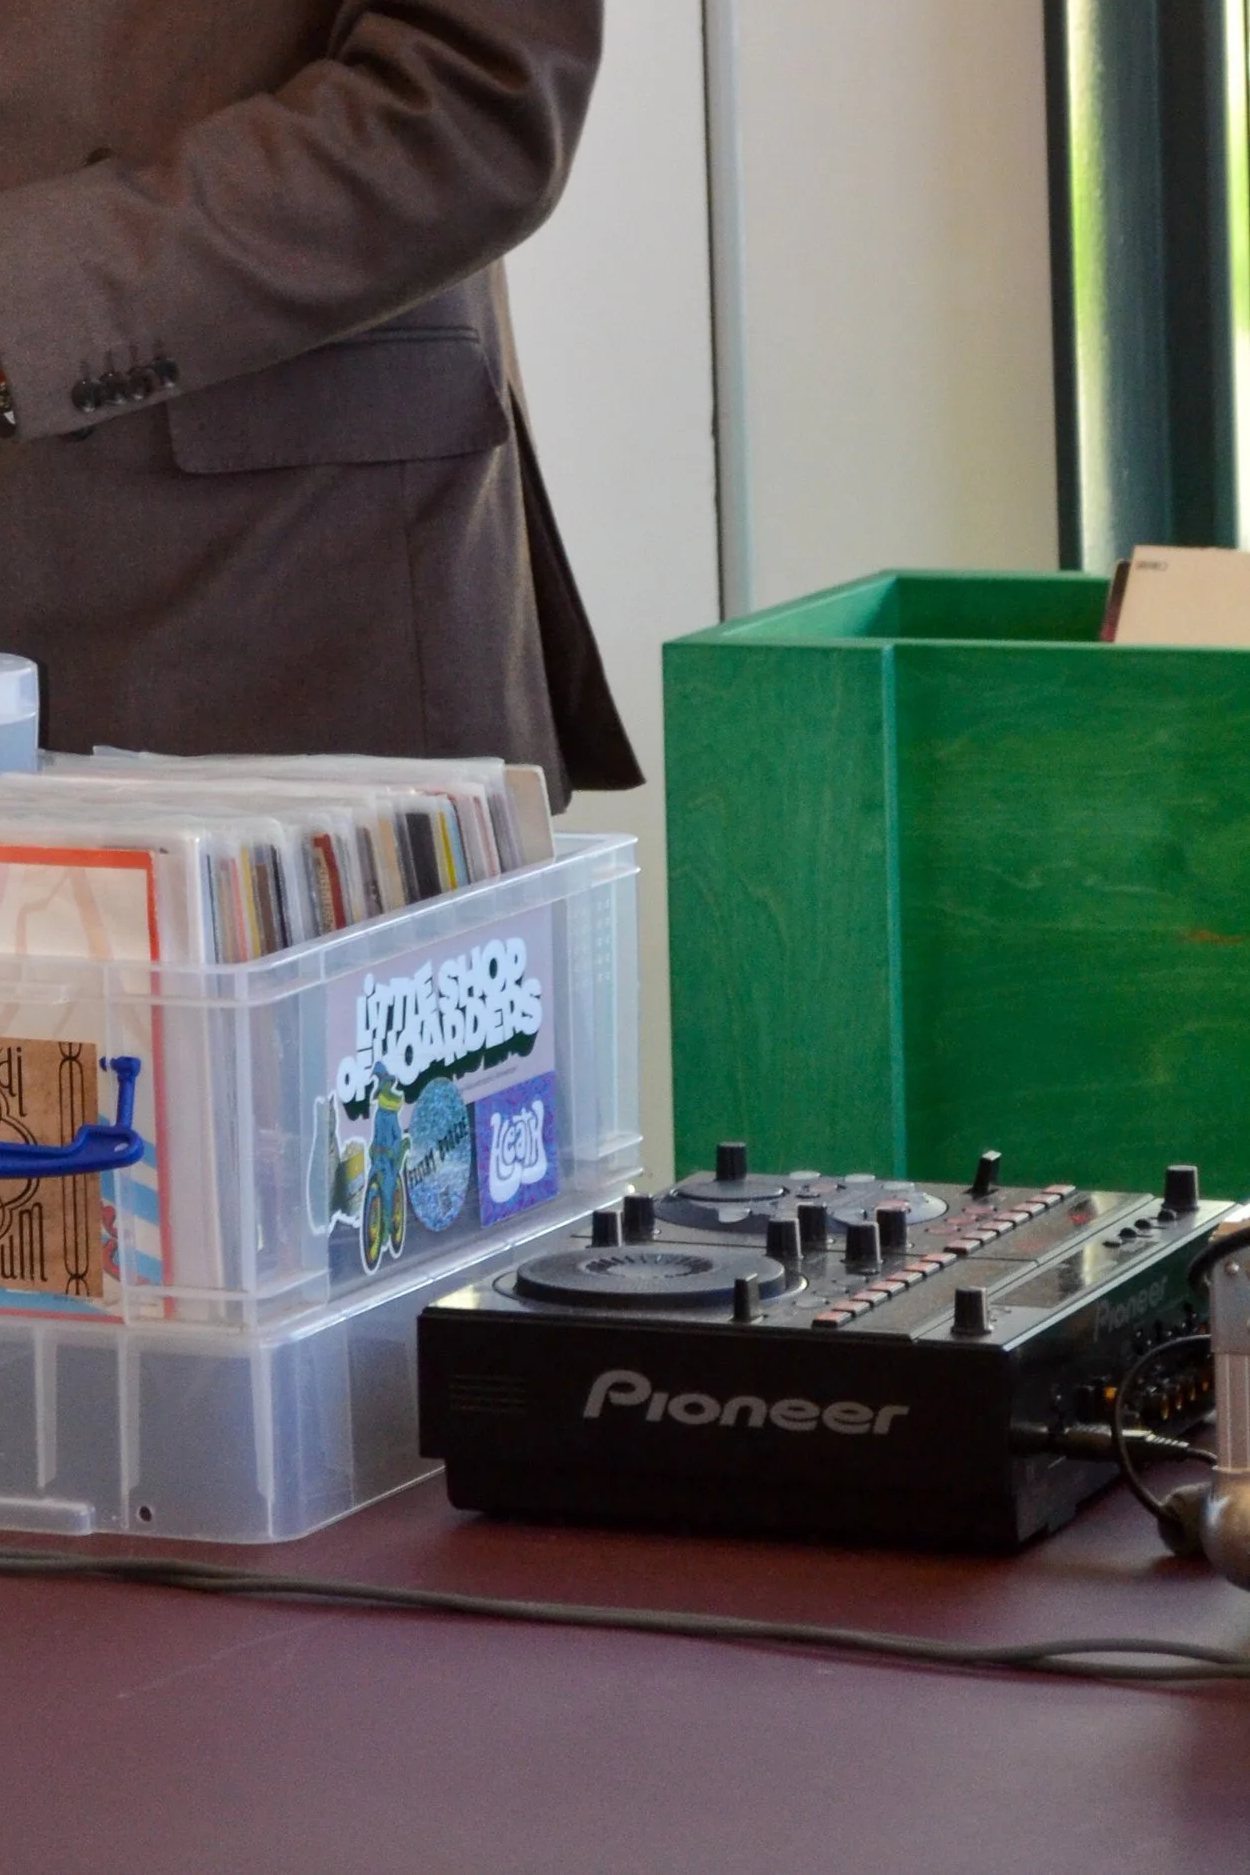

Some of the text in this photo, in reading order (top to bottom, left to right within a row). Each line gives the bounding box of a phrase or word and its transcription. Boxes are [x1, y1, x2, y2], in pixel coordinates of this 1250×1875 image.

[437, 936, 527, 1015] SHOP
[337, 977, 544, 1105] OF HOARDERS
[583, 1369, 911, 1435] Pioneer
